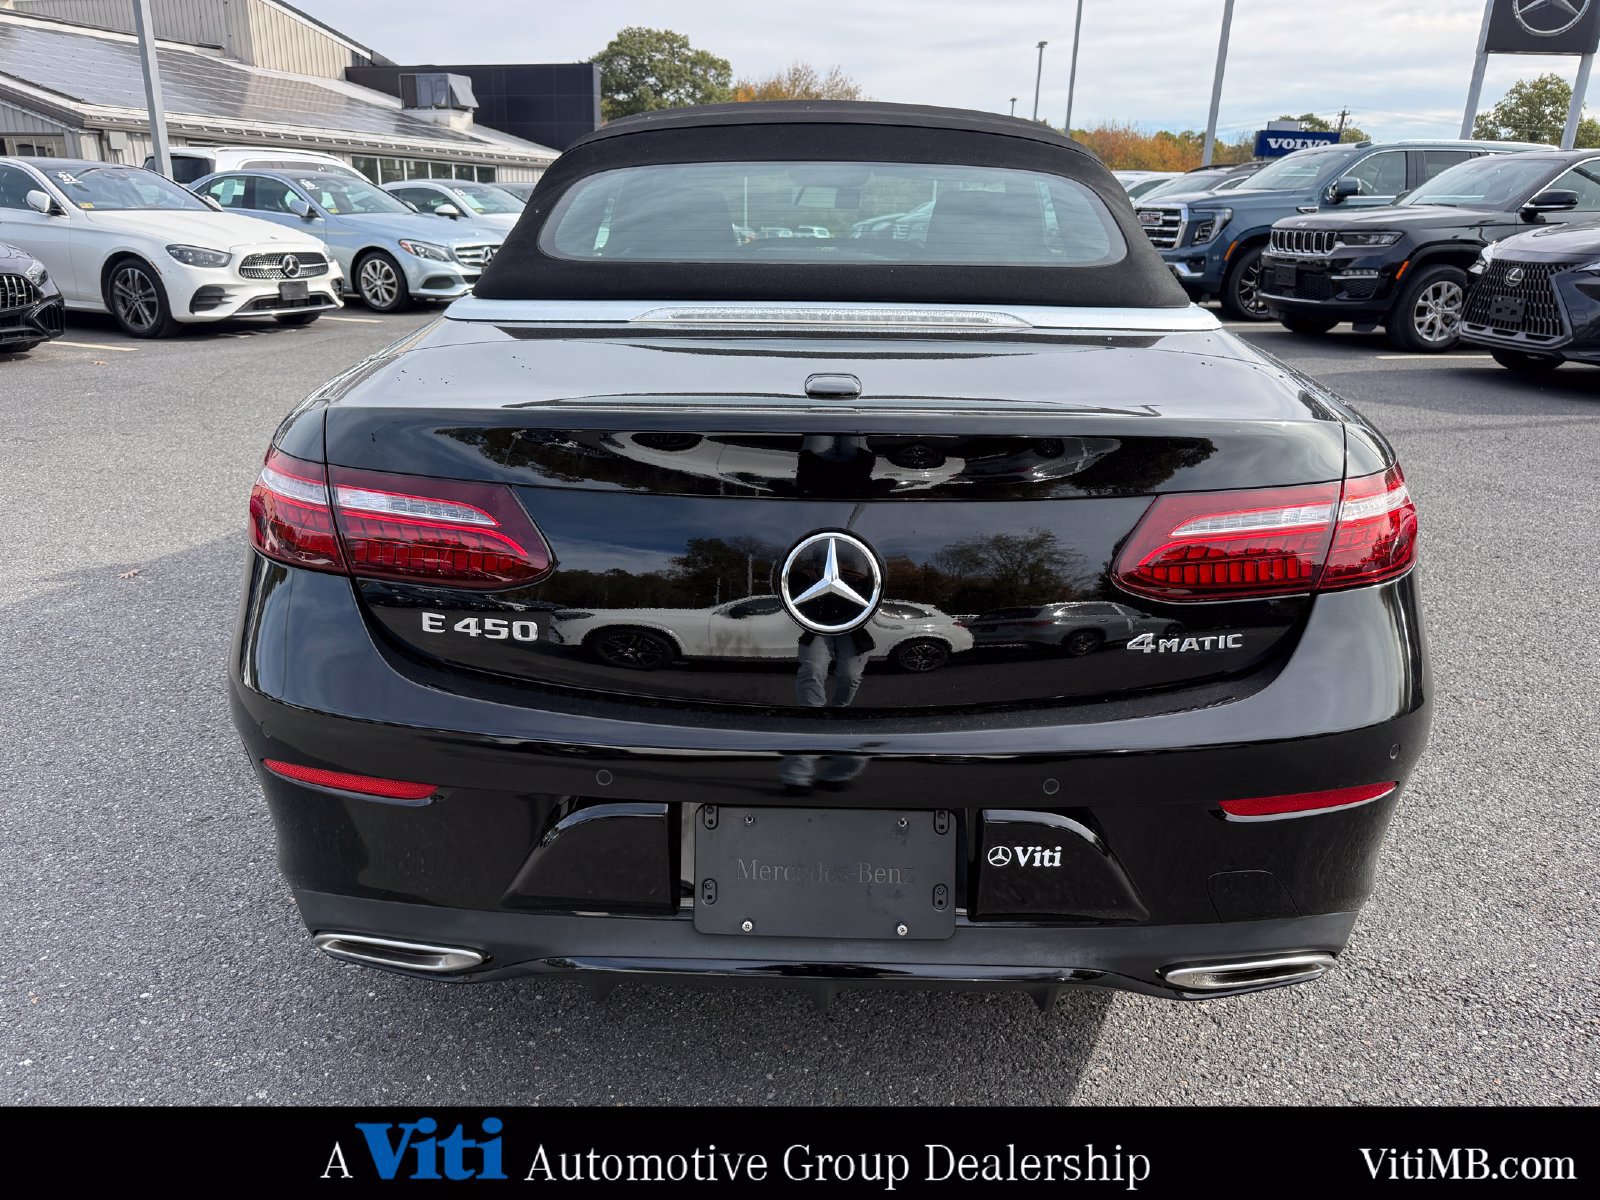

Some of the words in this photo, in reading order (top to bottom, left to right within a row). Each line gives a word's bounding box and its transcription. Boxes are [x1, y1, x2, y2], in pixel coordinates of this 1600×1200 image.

[421, 611, 446, 634] E
[453, 617, 539, 641] 450
[1126, 632, 1243, 653] 4MATIC
[1013, 846, 1062, 867] Viti
[736, 858, 916, 885] Mercedes-Benz
